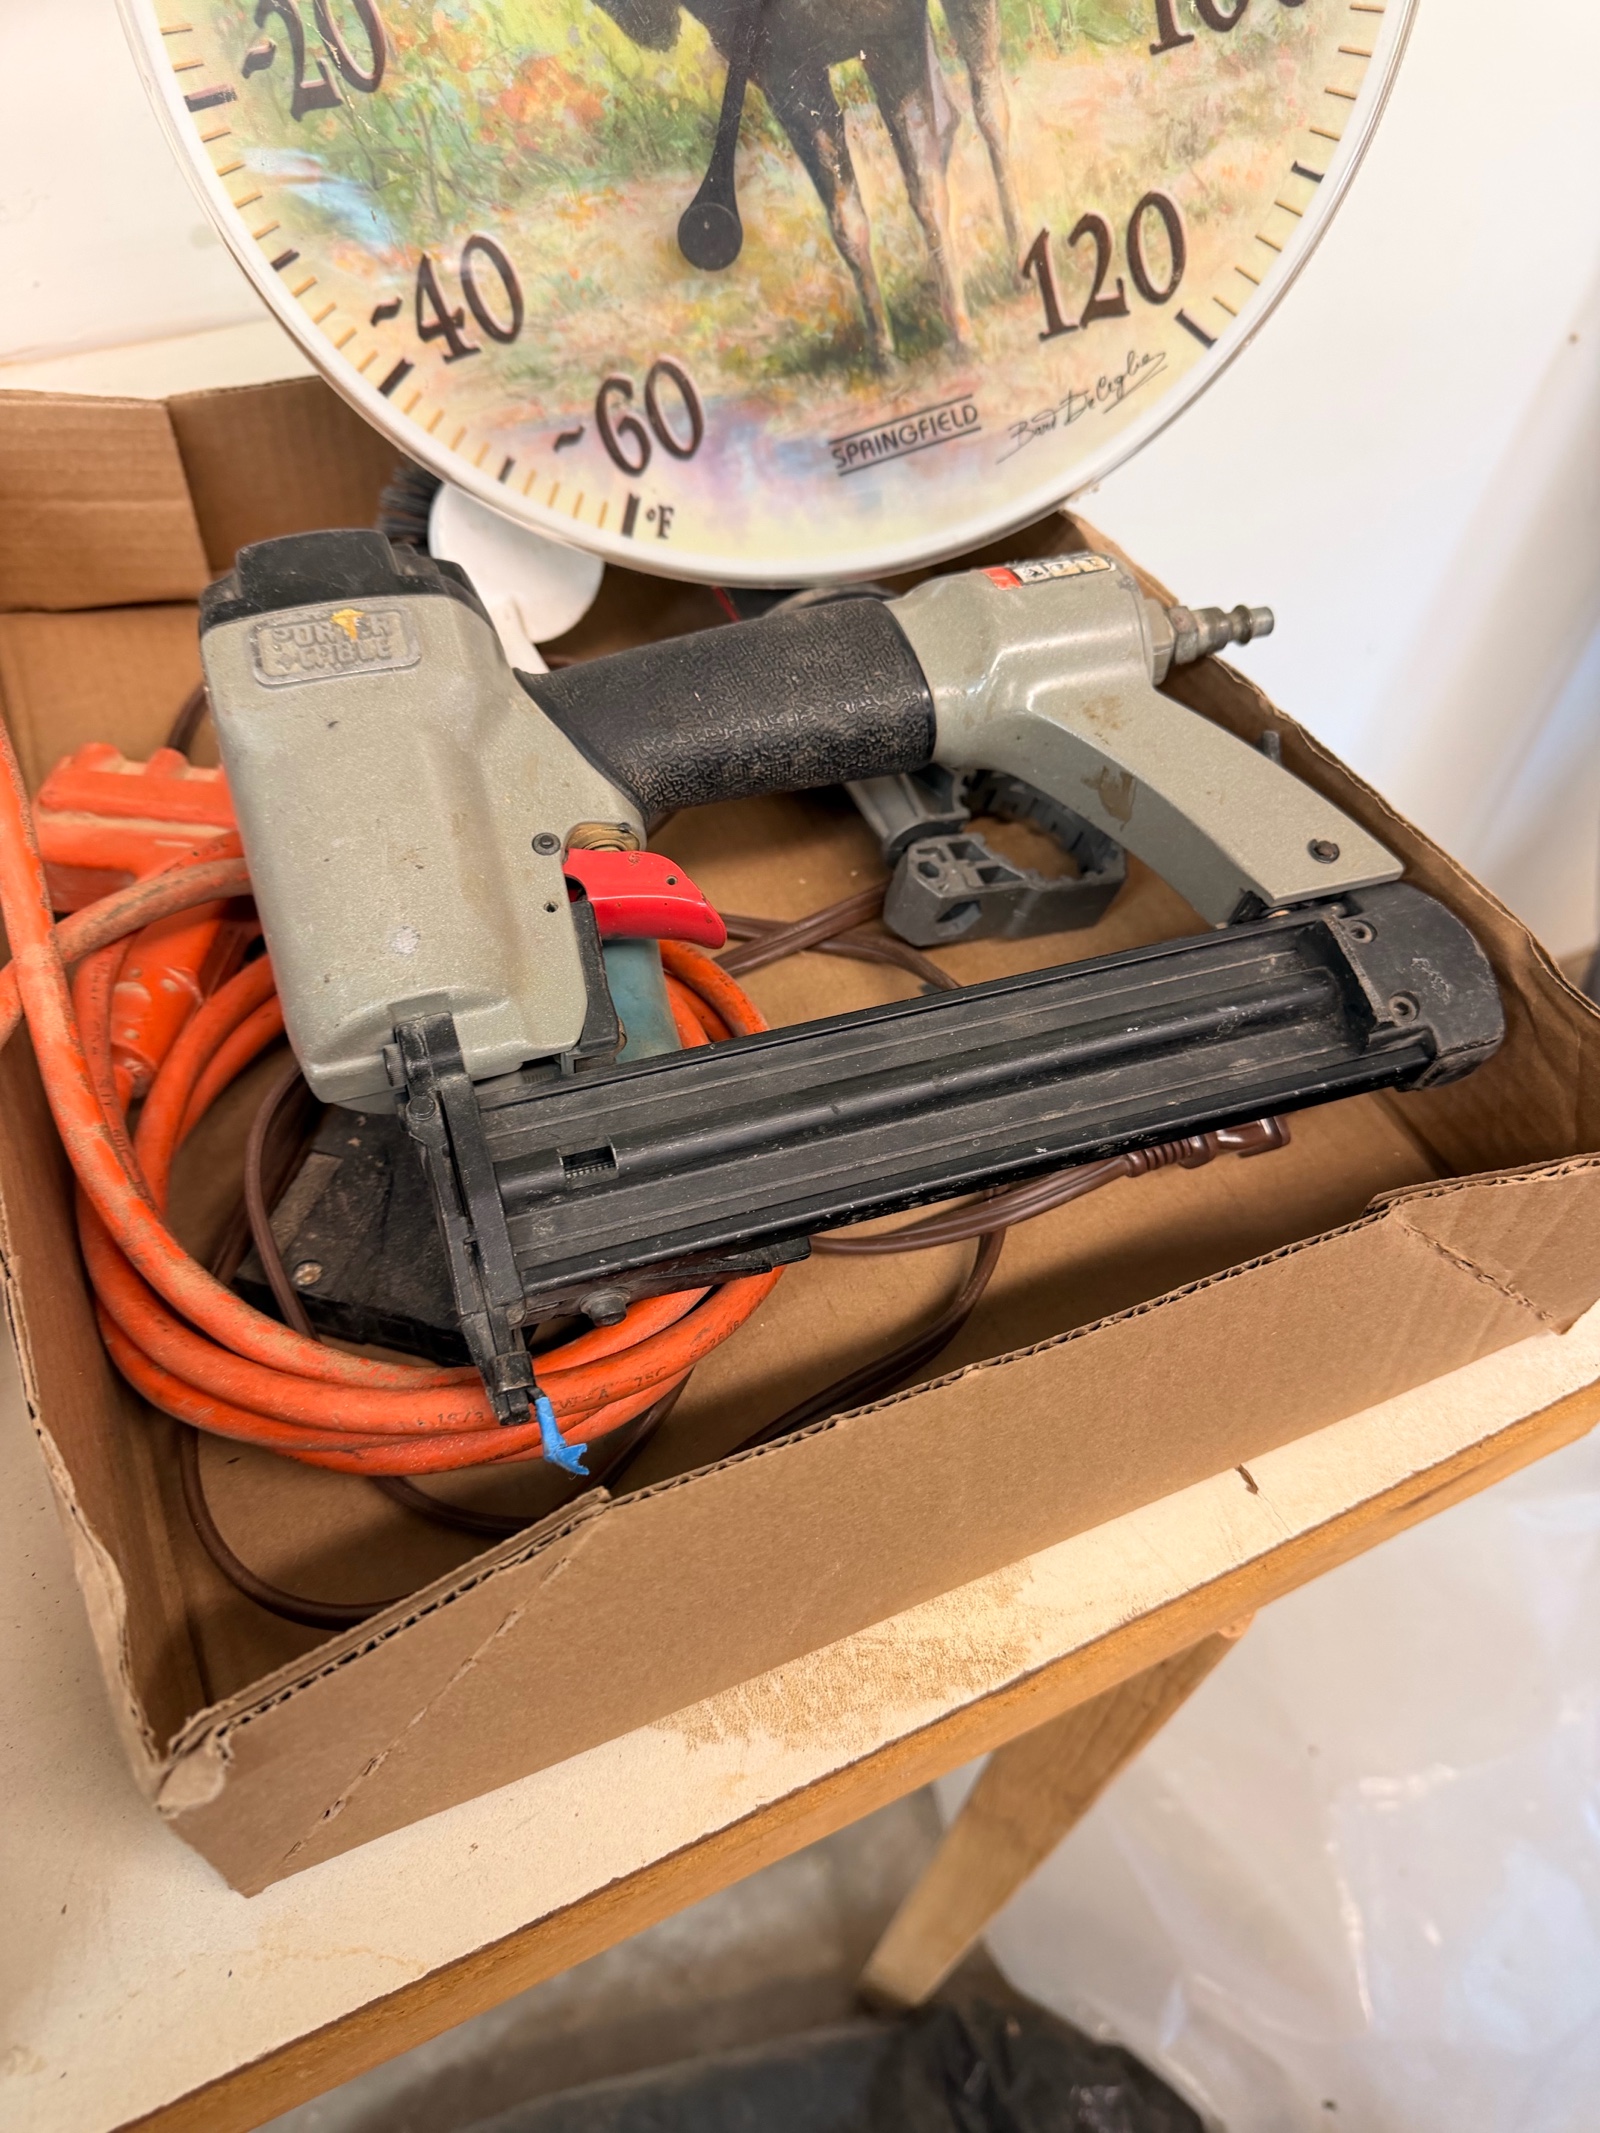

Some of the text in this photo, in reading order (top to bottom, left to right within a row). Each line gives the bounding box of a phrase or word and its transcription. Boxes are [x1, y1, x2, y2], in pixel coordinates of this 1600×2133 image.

[371, 232, 524, 364] -40
[1021, 190, 1188, 341] 120
[552, 355, 703, 477] -60
[831, 404, 978, 469] SPRINGFIELD
